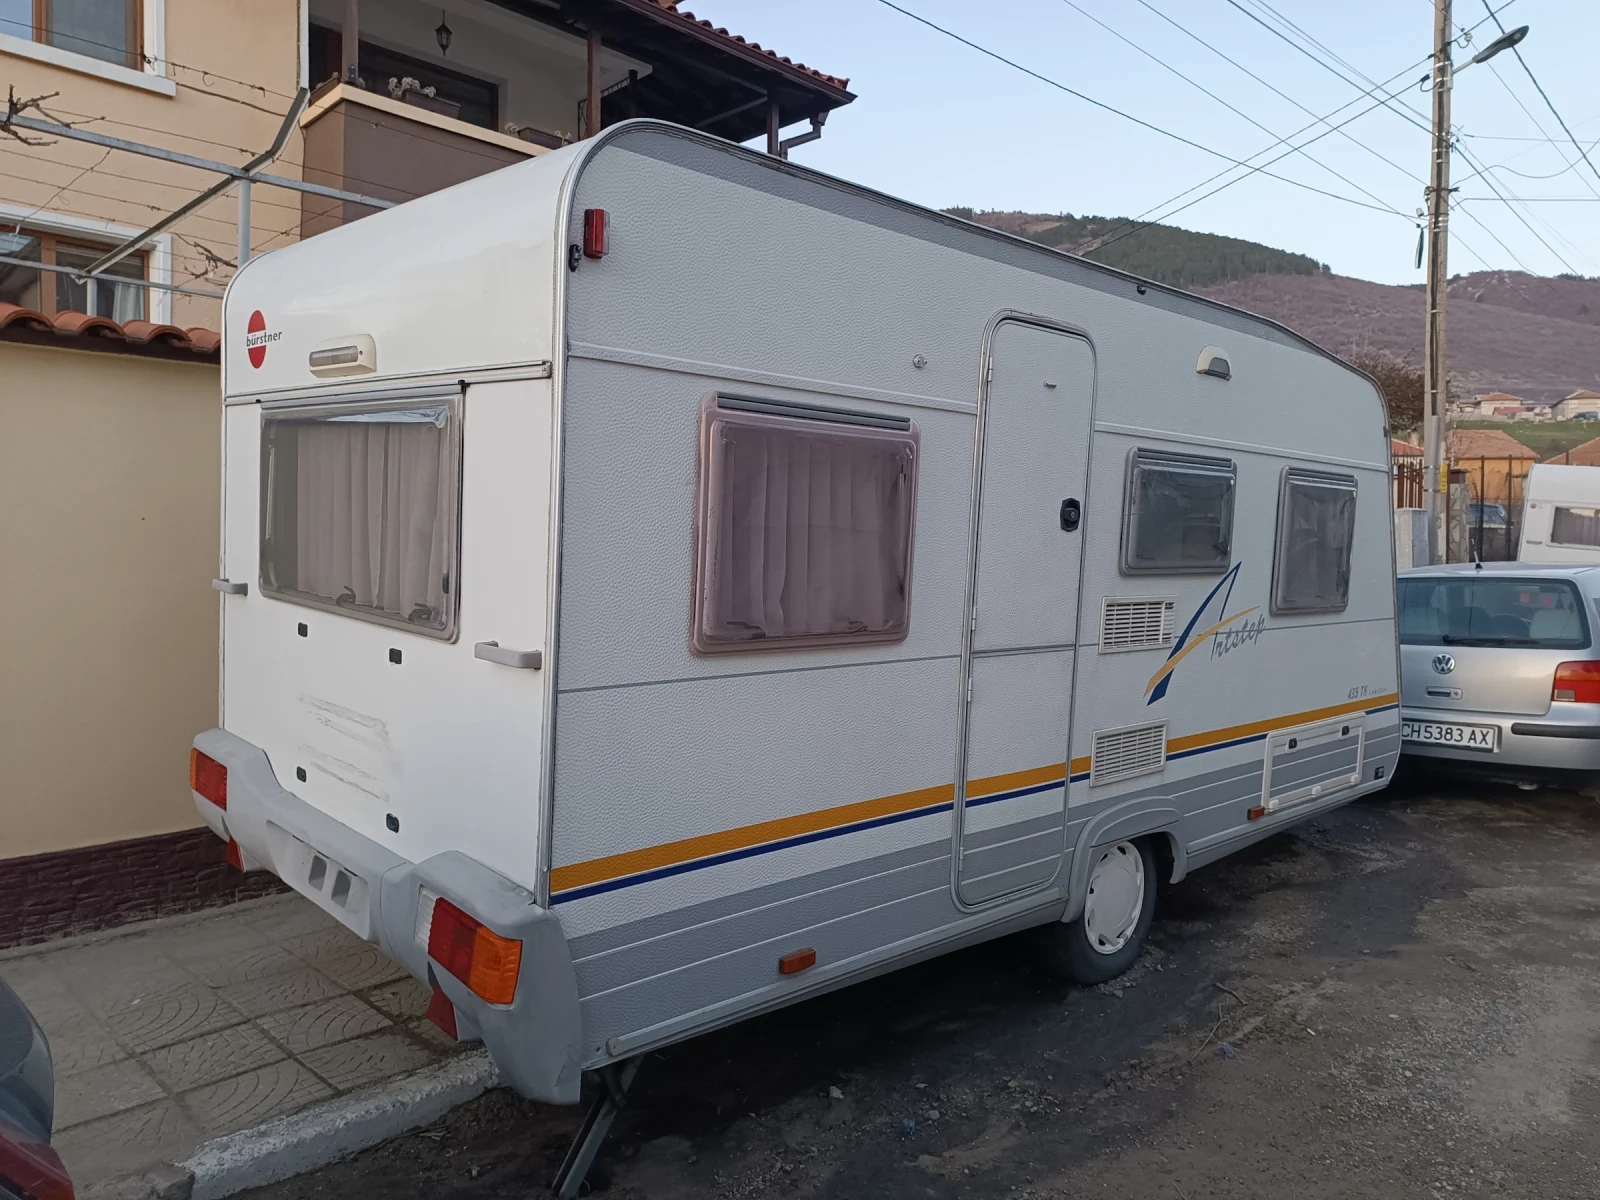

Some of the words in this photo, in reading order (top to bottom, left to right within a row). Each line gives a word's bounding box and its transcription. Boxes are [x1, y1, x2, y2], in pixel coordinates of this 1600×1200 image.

[246, 331, 283, 347] bürstner
[1401, 723, 1421, 739] CH
[1423, 725, 1464, 743] 5383
[1467, 729, 1490, 746] AX
